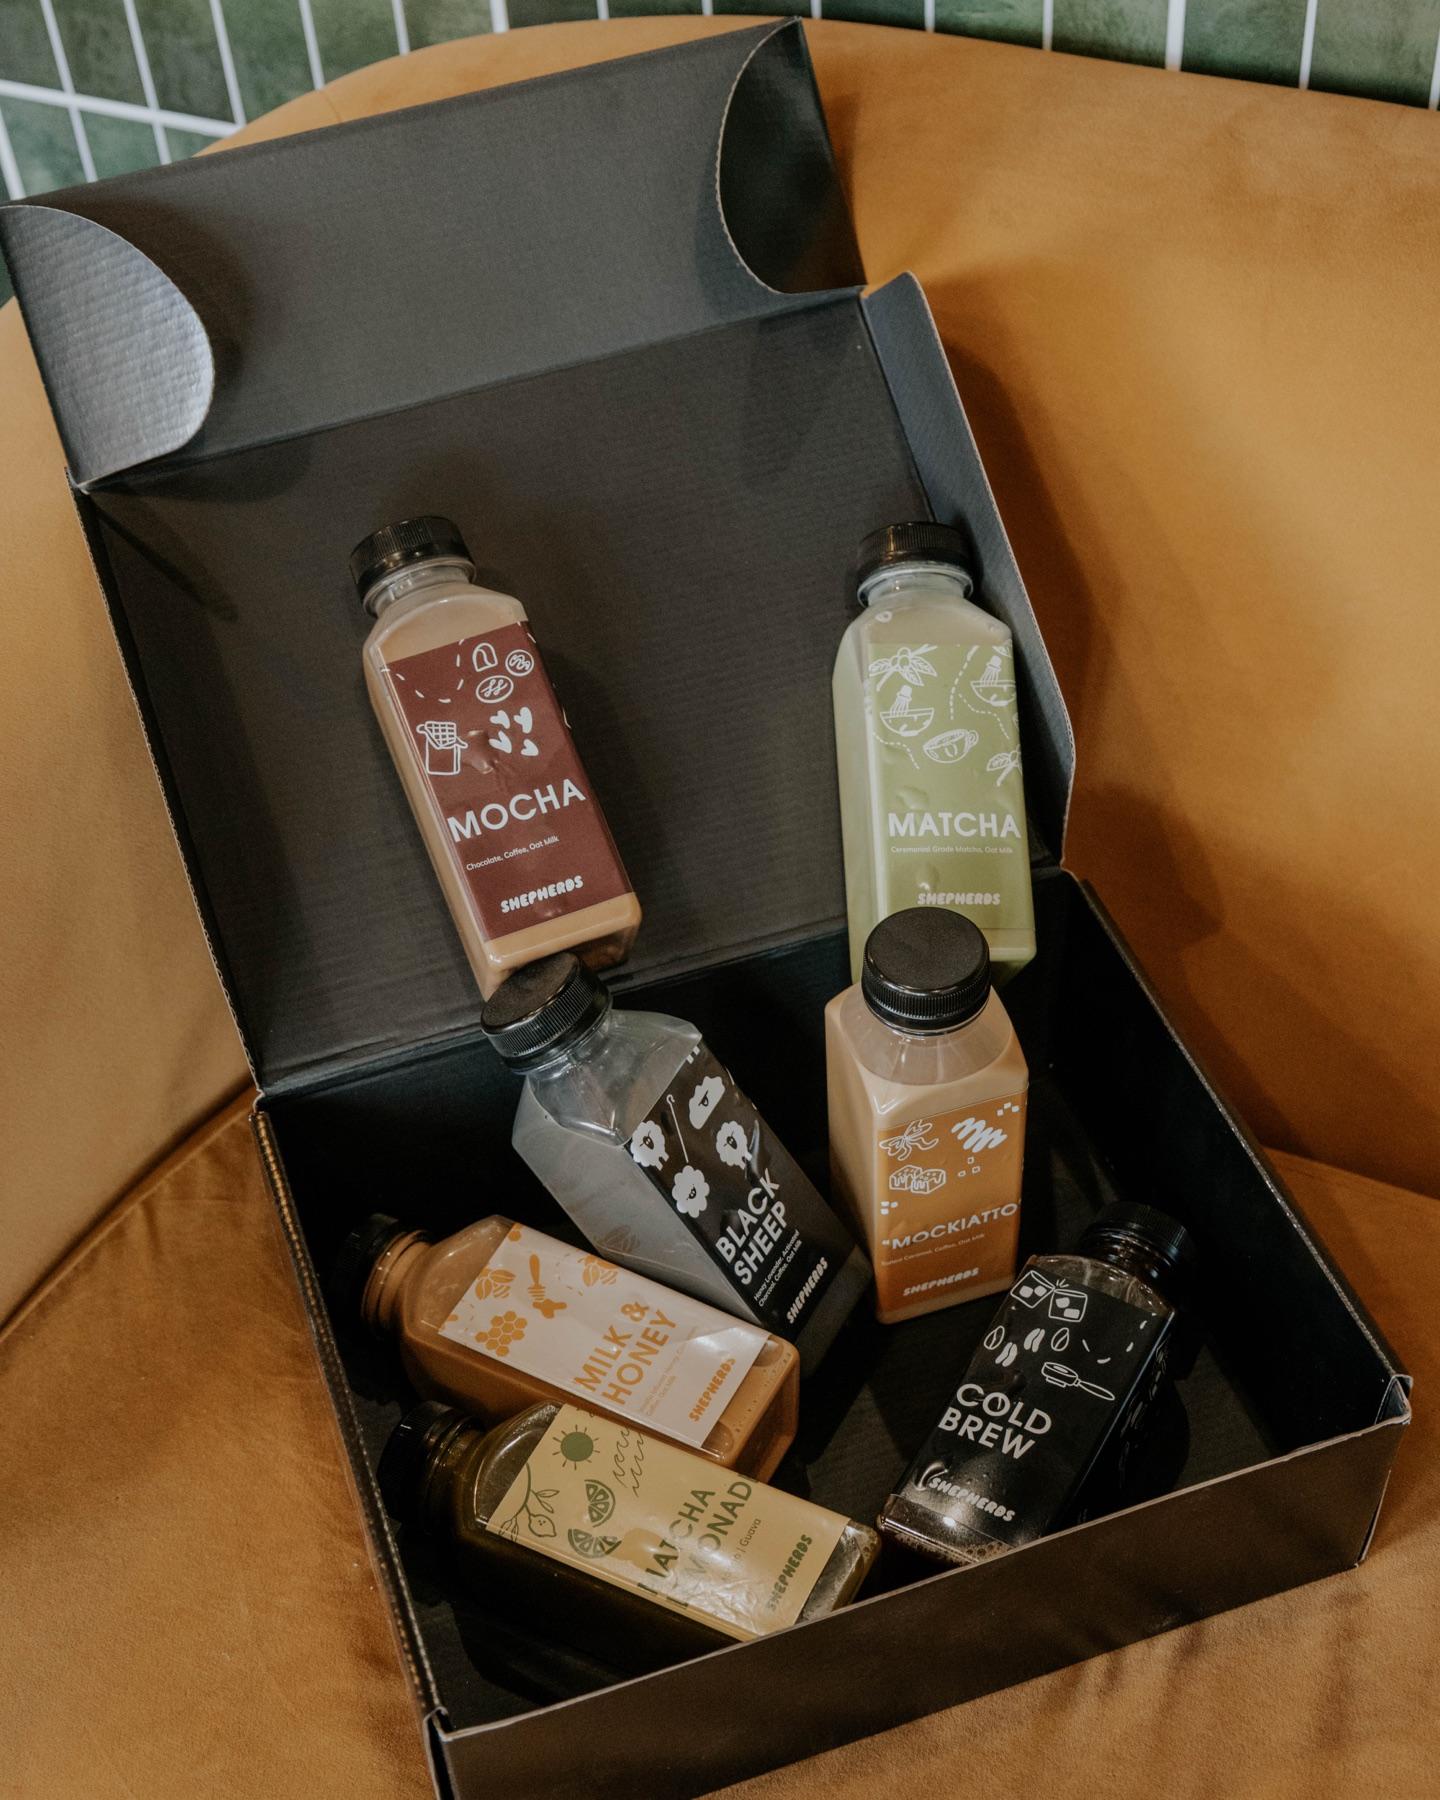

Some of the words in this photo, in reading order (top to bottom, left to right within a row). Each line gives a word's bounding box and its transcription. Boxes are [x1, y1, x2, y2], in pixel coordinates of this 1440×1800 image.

[446, 778, 586, 842] MOCHA
[888, 812, 1021, 838] MATCHA
[466, 855, 503, 871] Chocolate,
[503, 847, 529, 859] Coffee,
[529, 841, 544, 850] Oat
[543, 835, 560, 845] Milk
[500, 875, 584, 914] SHEPHERDS
[917, 892, 1001, 906] SHEPHERDS
[715, 1168, 780, 1263] BLACK
[734, 1201, 788, 1285] SHEEP
[786, 1256, 828, 1324] SHEPHERDS
[903, 1267, 979, 1296] SHEPHERDS
[574, 1325, 633, 1392] MILK
[620, 1302, 650, 1322] &
[602, 1309, 677, 1405] HONEY
[689, 1357, 737, 1422] SHEPHERDS
[956, 1383, 1052, 1435] COLD
[938, 1406, 1036, 1460] BREW
[929, 1478, 1016, 1522] SHEPHERDS
[740, 1518, 761, 1547] Guava
